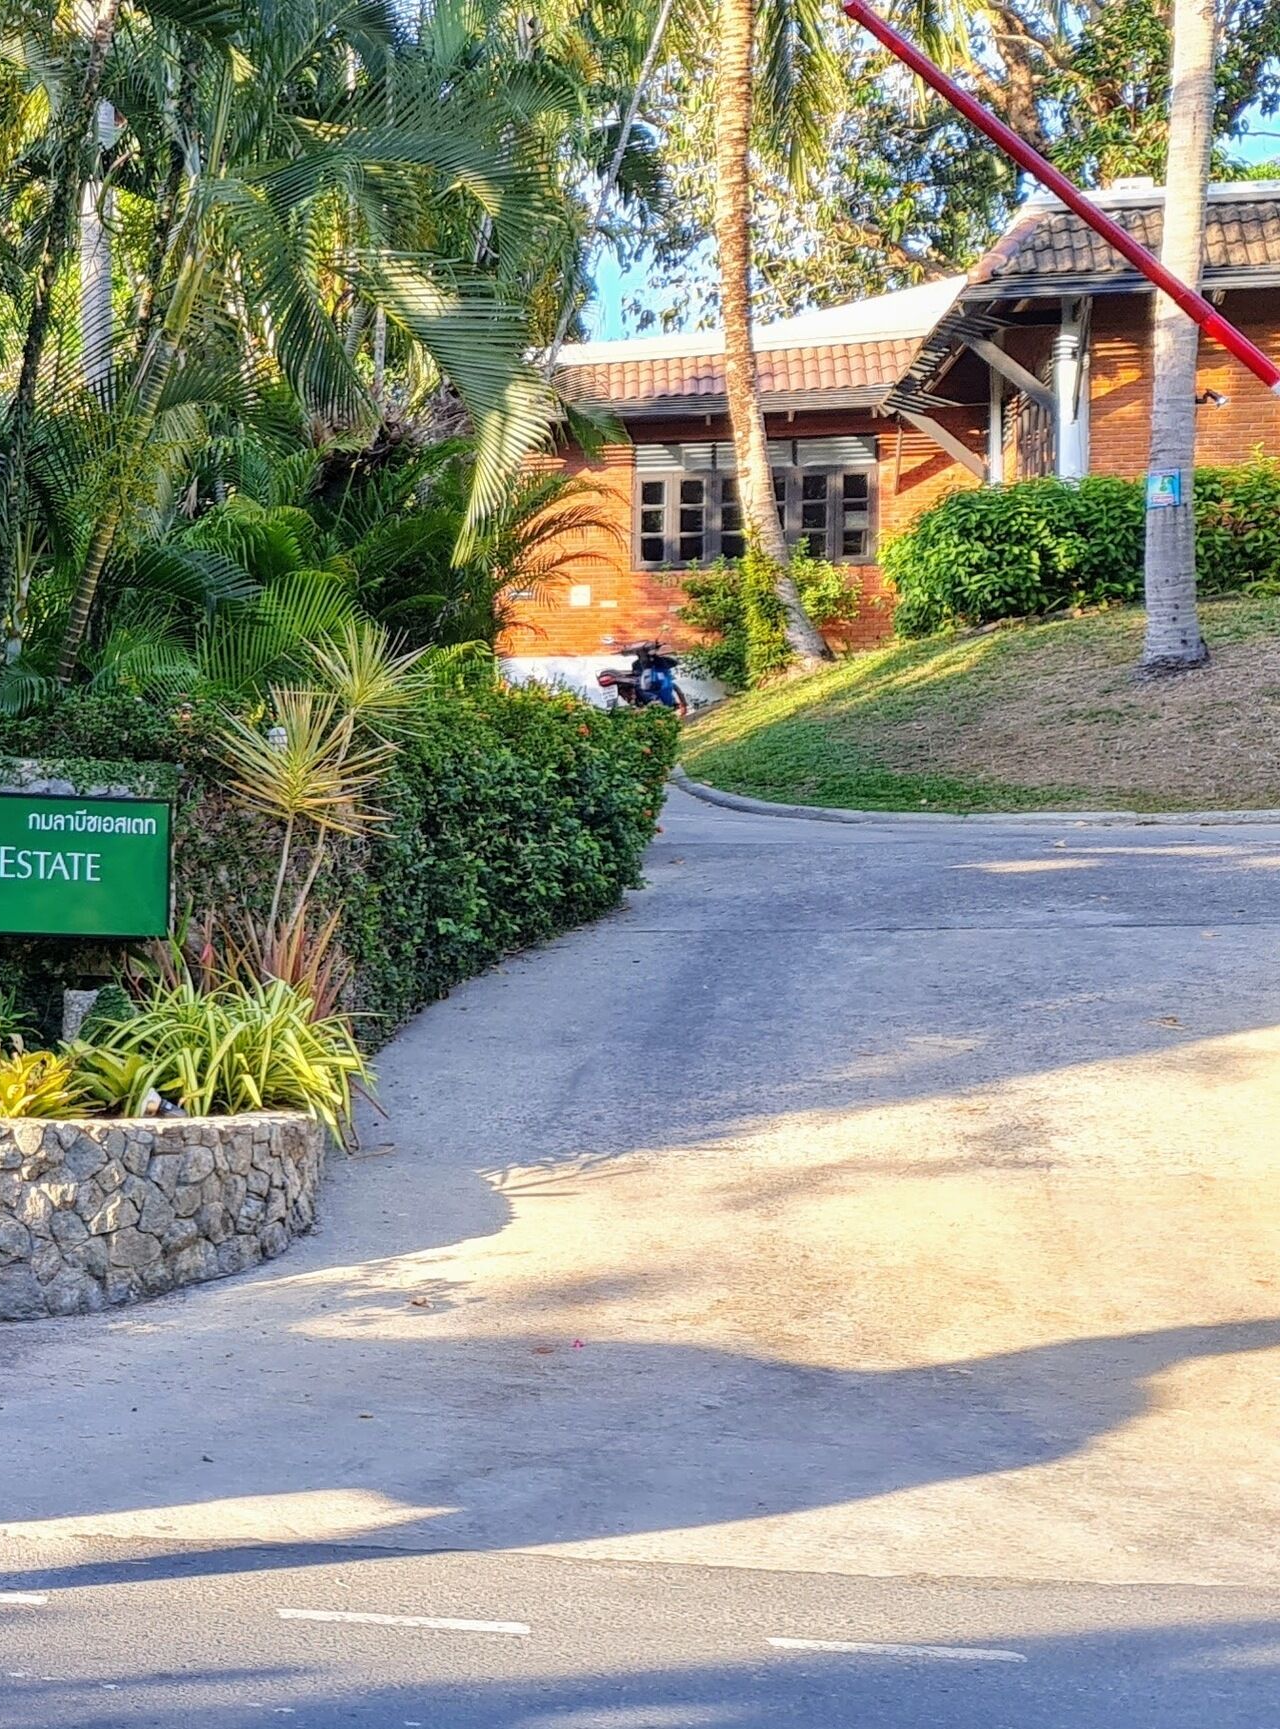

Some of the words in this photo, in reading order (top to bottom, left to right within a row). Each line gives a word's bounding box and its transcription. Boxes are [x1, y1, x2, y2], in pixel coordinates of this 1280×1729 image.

[28, 809, 157, 835] กมลาบีชเอสเตท
[0, 846, 101, 881] ESTATE
